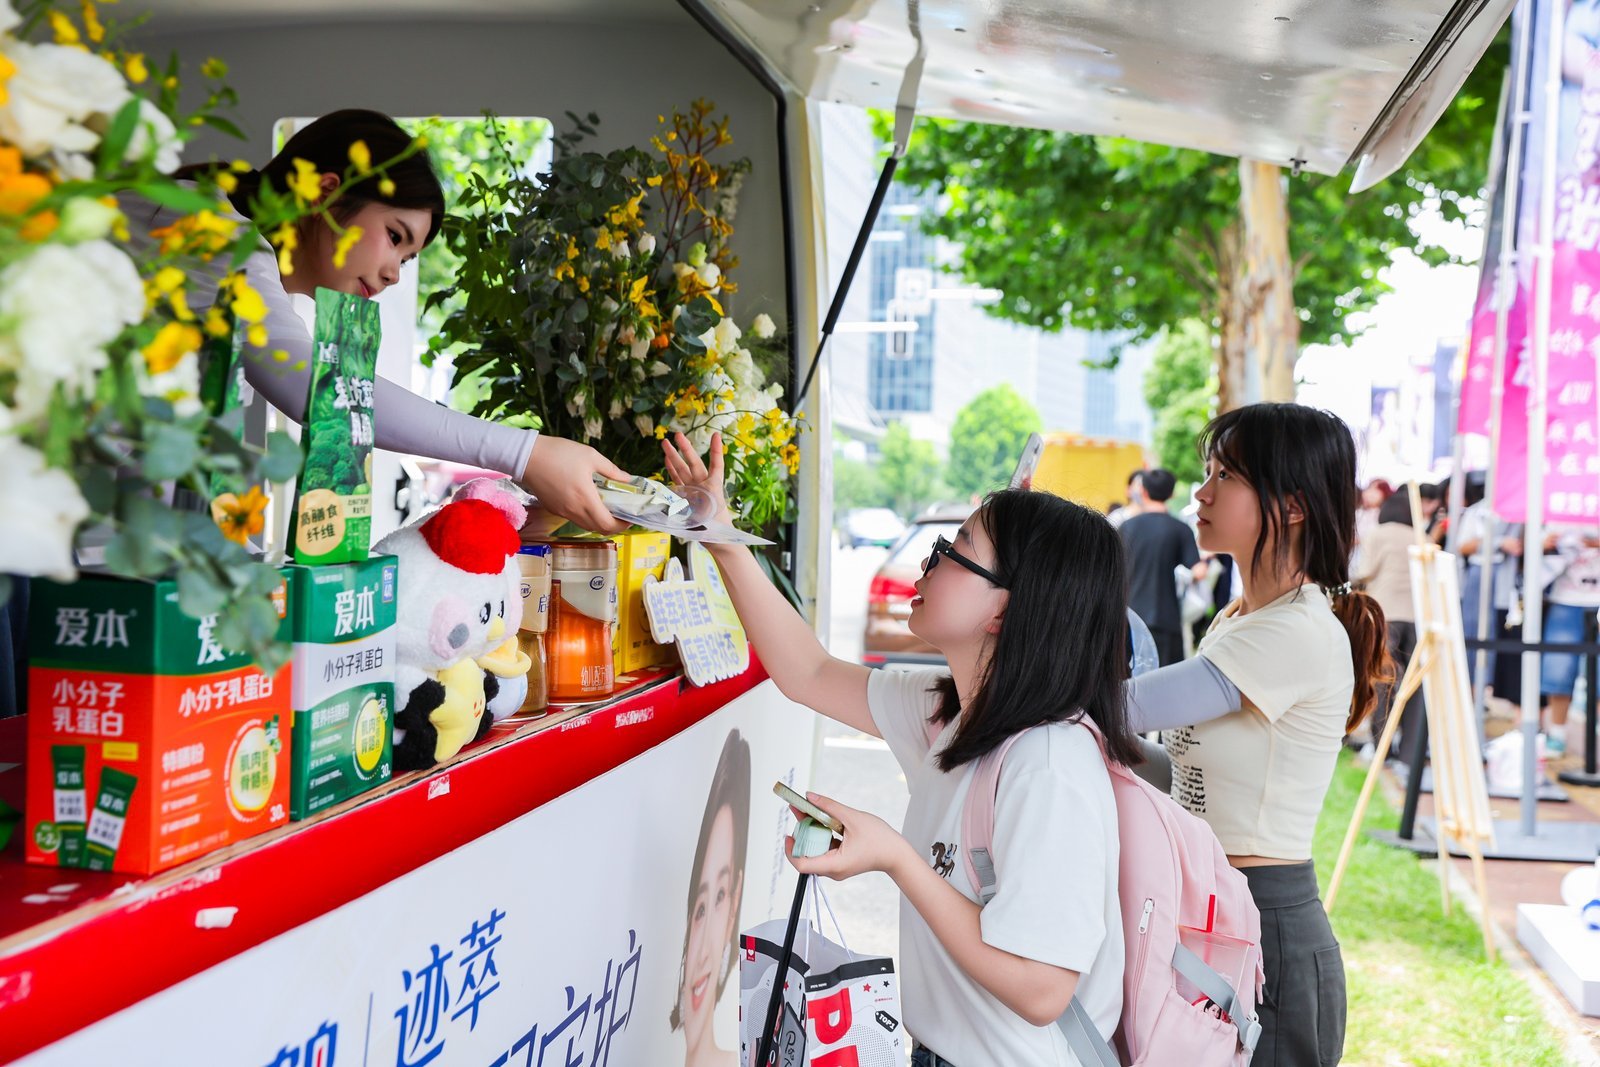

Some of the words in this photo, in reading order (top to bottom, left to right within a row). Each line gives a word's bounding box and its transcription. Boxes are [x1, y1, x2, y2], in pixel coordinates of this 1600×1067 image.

[300, 503, 338, 528] 高膳食
[306, 523, 336, 543] 纤维
[55, 607, 129, 648] 爱本
[334, 586, 375, 637] 爱本
[324, 647, 383, 683] 小分子乳蛋白
[52, 678, 125, 708] 小分子
[178, 673, 273, 717] 小分子乳蛋白
[52, 706, 123, 737] 乳蛋白
[394, 908, 506, 1067] 迹萃
[878, 1012, 896, 1031] TOP1
